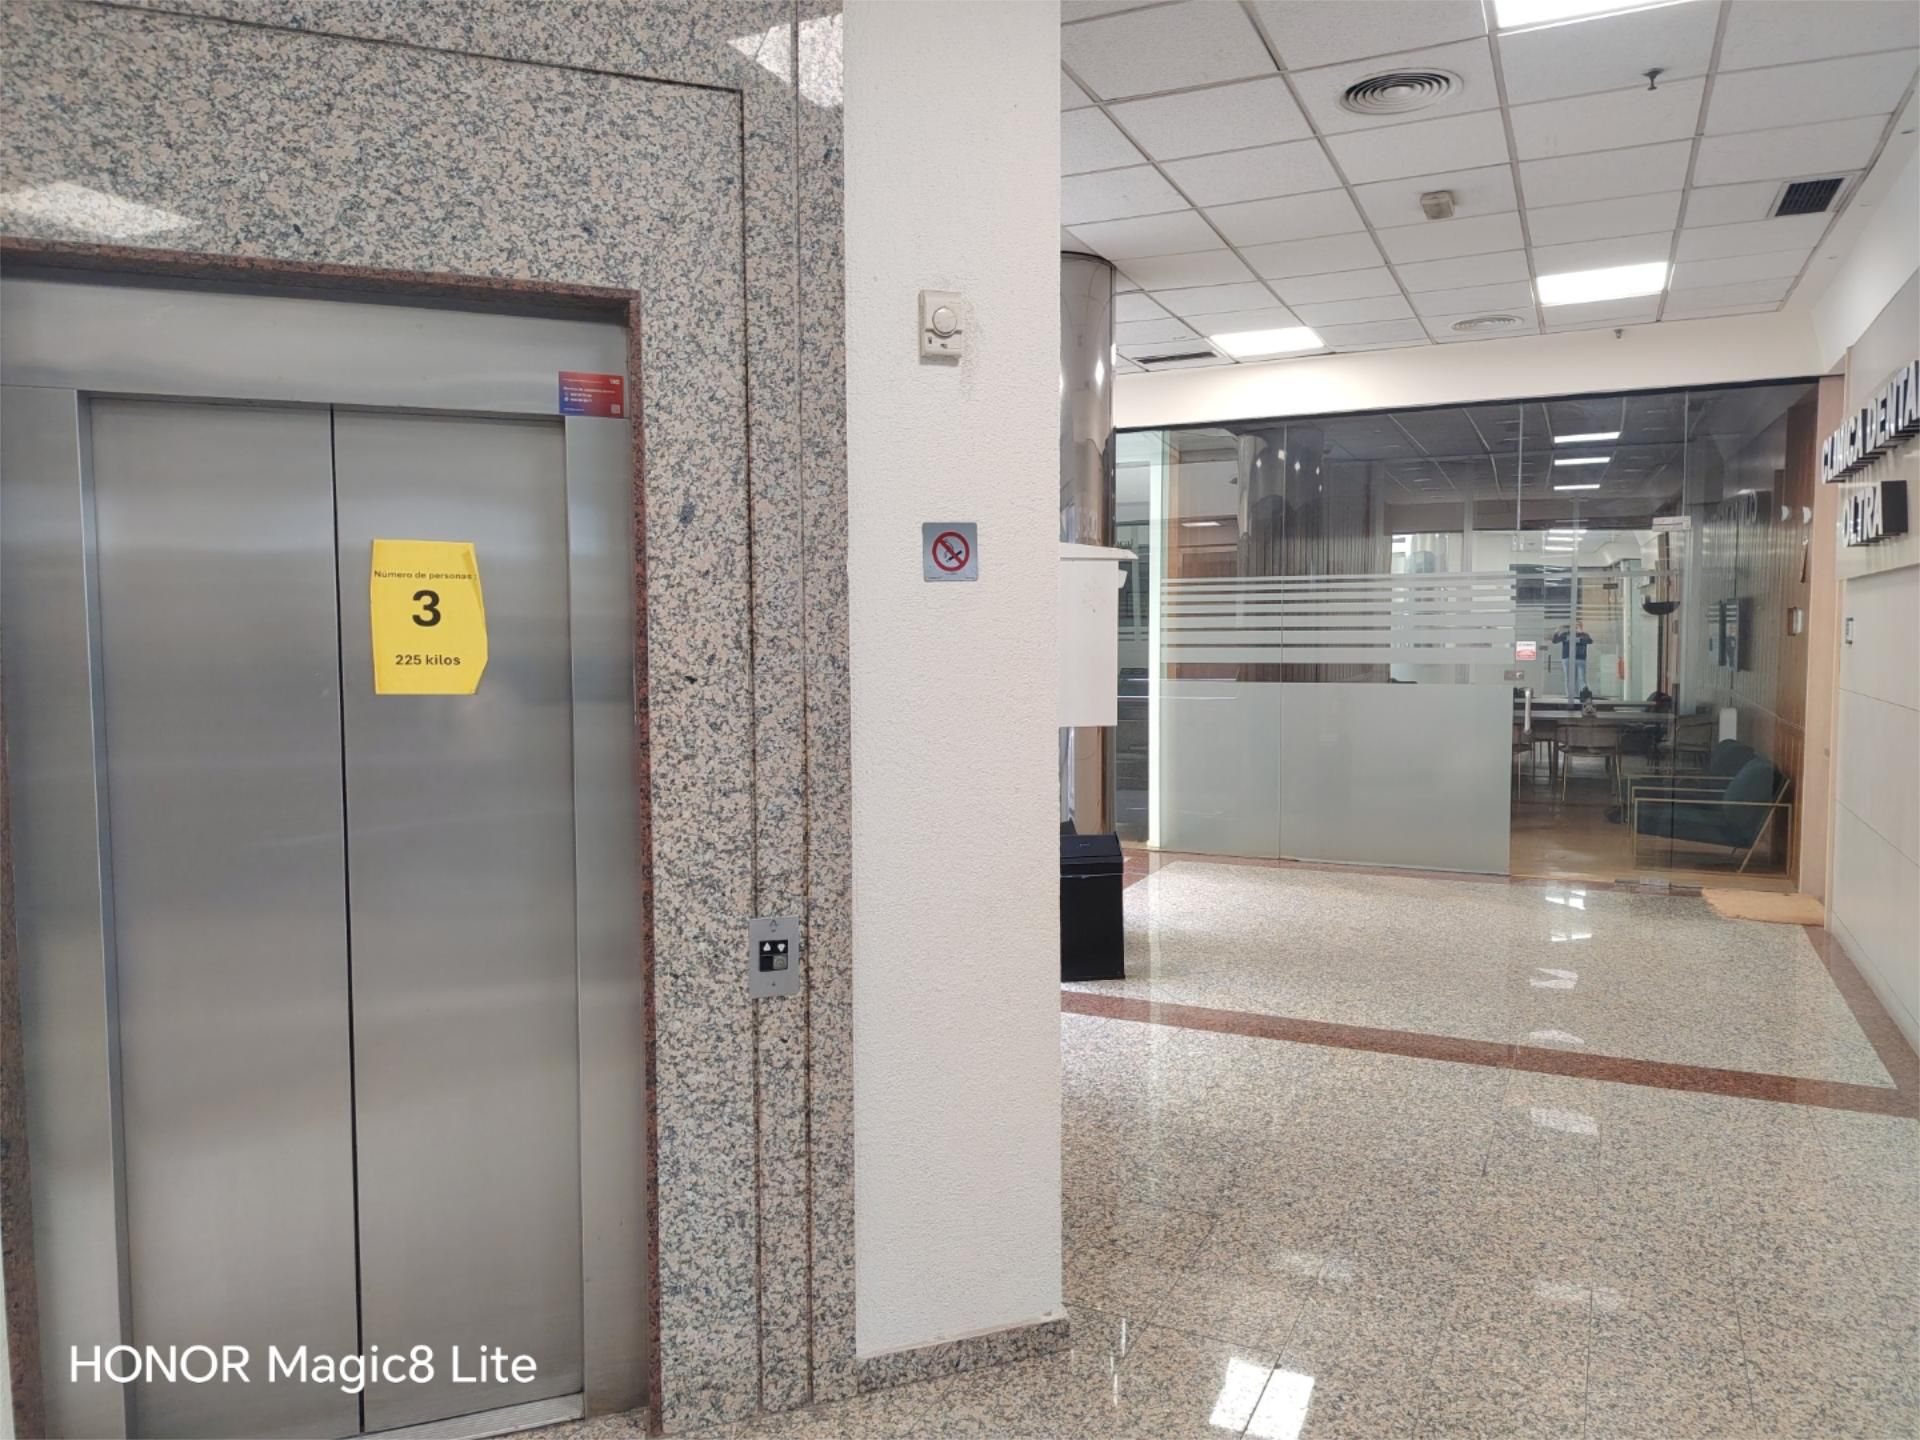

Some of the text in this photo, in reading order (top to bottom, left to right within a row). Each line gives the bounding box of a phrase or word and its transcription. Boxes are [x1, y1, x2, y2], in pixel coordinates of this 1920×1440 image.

[1866, 360, 1920, 454] DENTA
[414, 571, 426, 579] de
[412, 590, 441, 627] 3
[395, 653, 461, 666] 225 kilos
